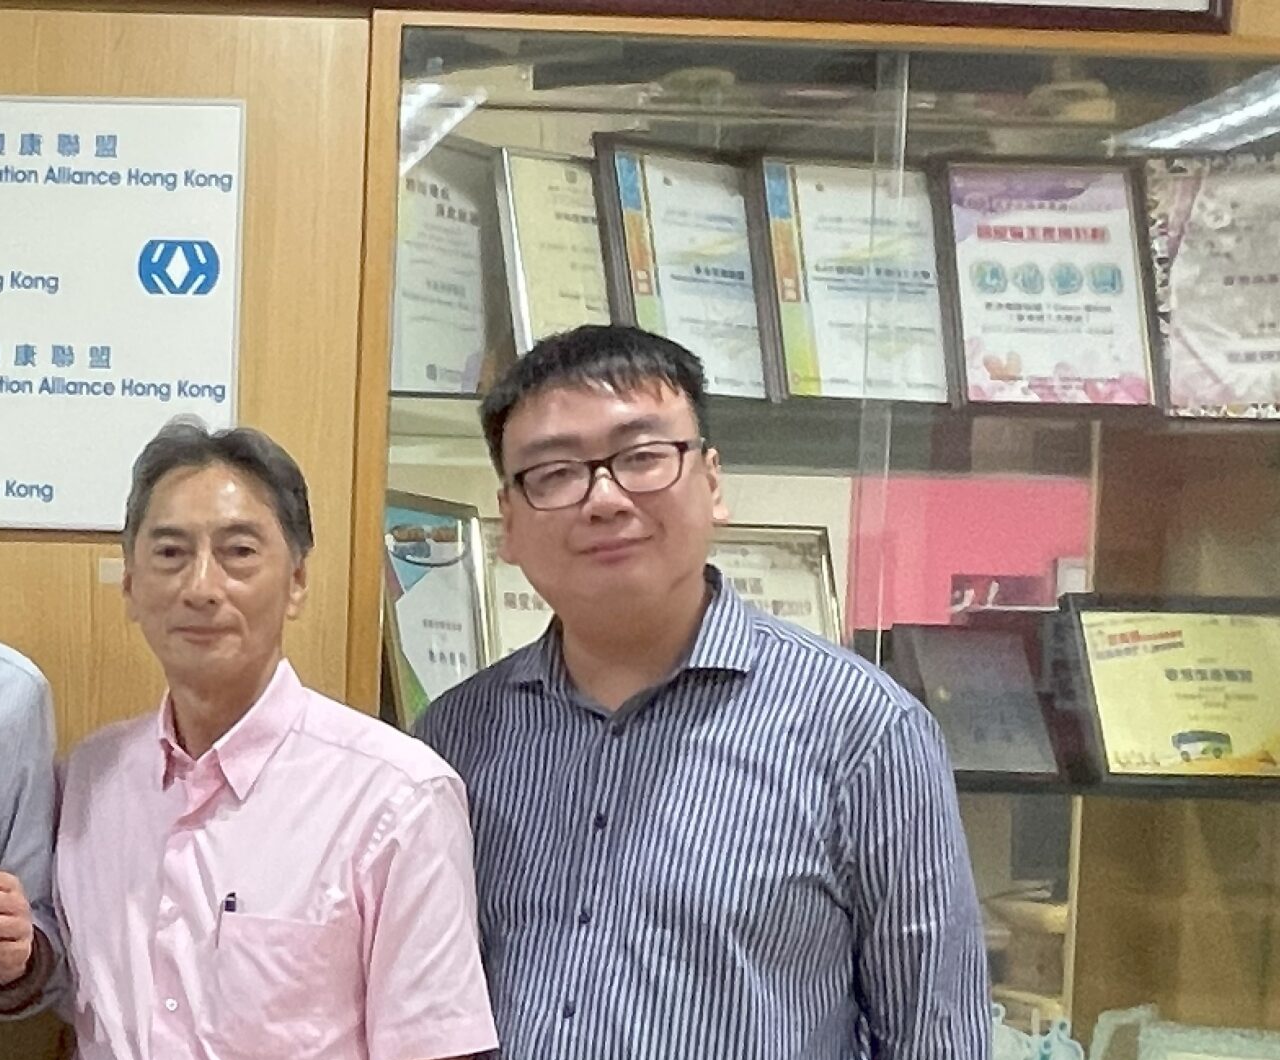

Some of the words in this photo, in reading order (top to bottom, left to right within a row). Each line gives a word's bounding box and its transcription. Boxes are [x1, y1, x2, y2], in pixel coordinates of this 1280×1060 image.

[44, 166, 121, 186] Alliance
[127, 168, 178, 191] Hong
[184, 169, 233, 192] Kong
[10, 271, 59, 294] Kong
[38, 376, 115, 395] Alliance
[122, 379, 171, 402] Hong
[177, 380, 225, 403] Kong
[5, 480, 53, 503] Kong
